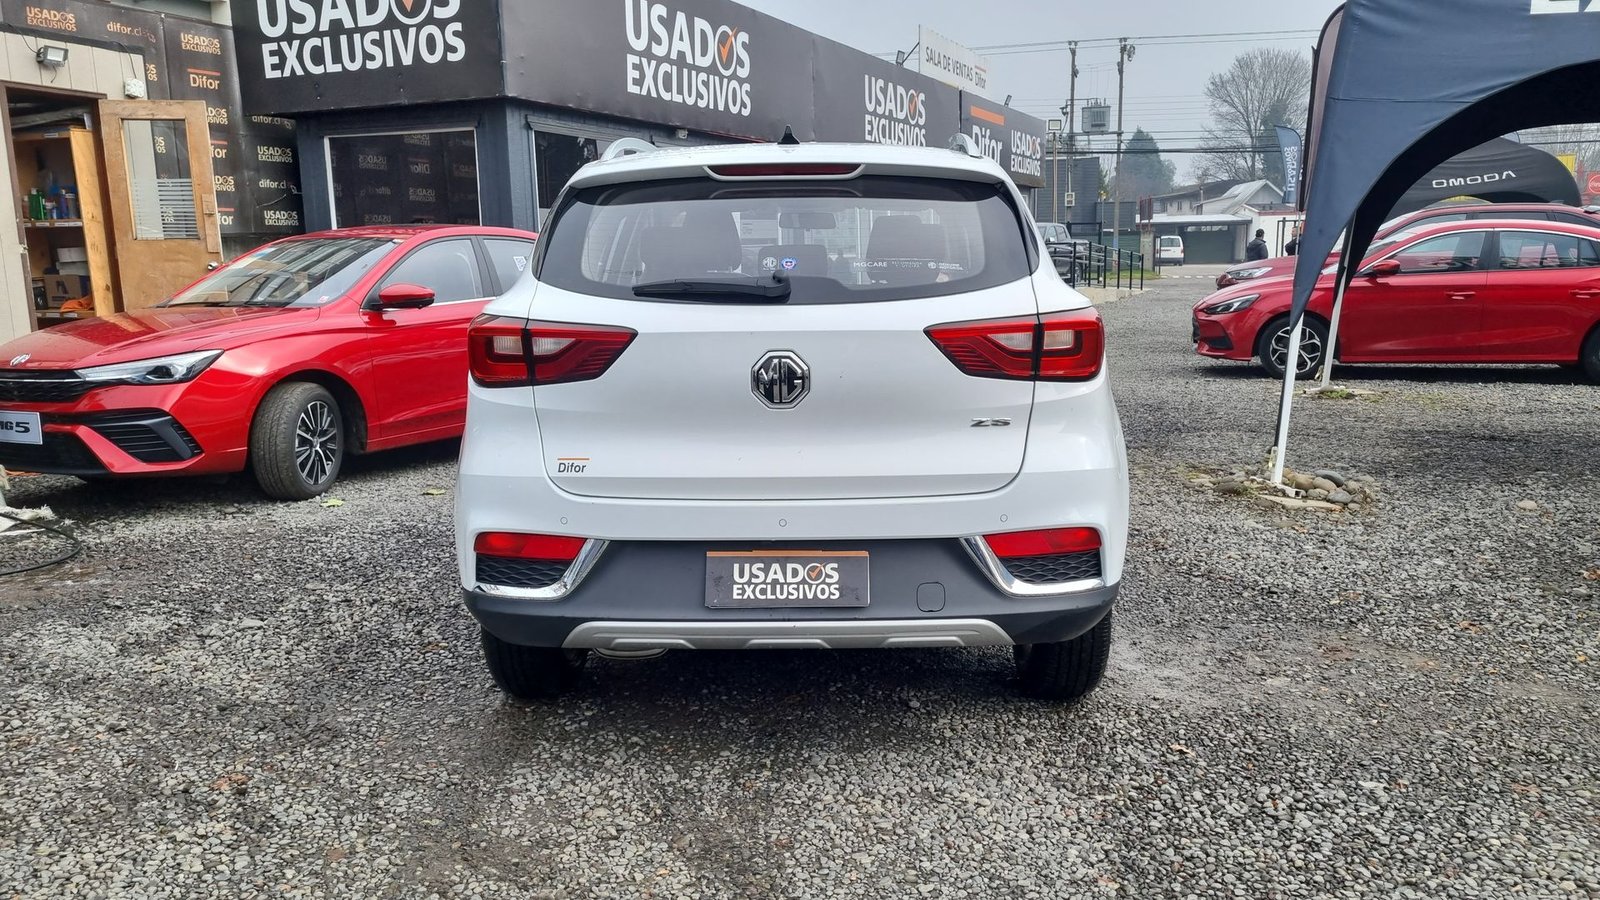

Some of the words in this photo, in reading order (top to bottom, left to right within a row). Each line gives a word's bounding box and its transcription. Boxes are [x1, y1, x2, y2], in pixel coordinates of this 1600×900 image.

[26, 6, 76, 24] USADOS
[27, 17, 77, 32] EXCLUSIVOS
[180, 32, 220, 49] USADOS
[625, 0, 750, 78] USADOS
[181, 43, 221, 55] EXCLUSIVOS
[261, 22, 466, 79] EXCLUSIVOS
[925, 46, 942, 69] SALA
[942, 54, 951, 73] DE
[951, 58, 973, 81] VENTAS
[189, 73, 220, 90] Difor
[627, 53, 752, 117] EXCLUSIVOS
[864, 74, 926, 126] USADOS
[207, 106, 228, 118] DOS
[865, 114, 926, 147] EXCLUSIVOS
[210, 145, 227, 158] for
[257, 145, 292, 157] USADOS
[1010, 129, 1041, 159] USADOS
[258, 154, 293, 163] EXCLUSIVOS
[1010, 154, 1041, 177] EXCLUSIVOS
[215, 175, 234, 185] DOS
[259, 179, 287, 189] difor.cl
[1431, 170, 1517, 188] OMODA
[263, 210, 298, 220] USADOS
[265, 218, 299, 226] EXCLUSIVOS
[758, 357, 803, 403] MG
[970, 417, 1011, 427] ZS
[557, 462, 587, 473] Difor
[733, 562, 840, 584] USADOS
[732, 584, 840, 600] EXCLUSIVOS
